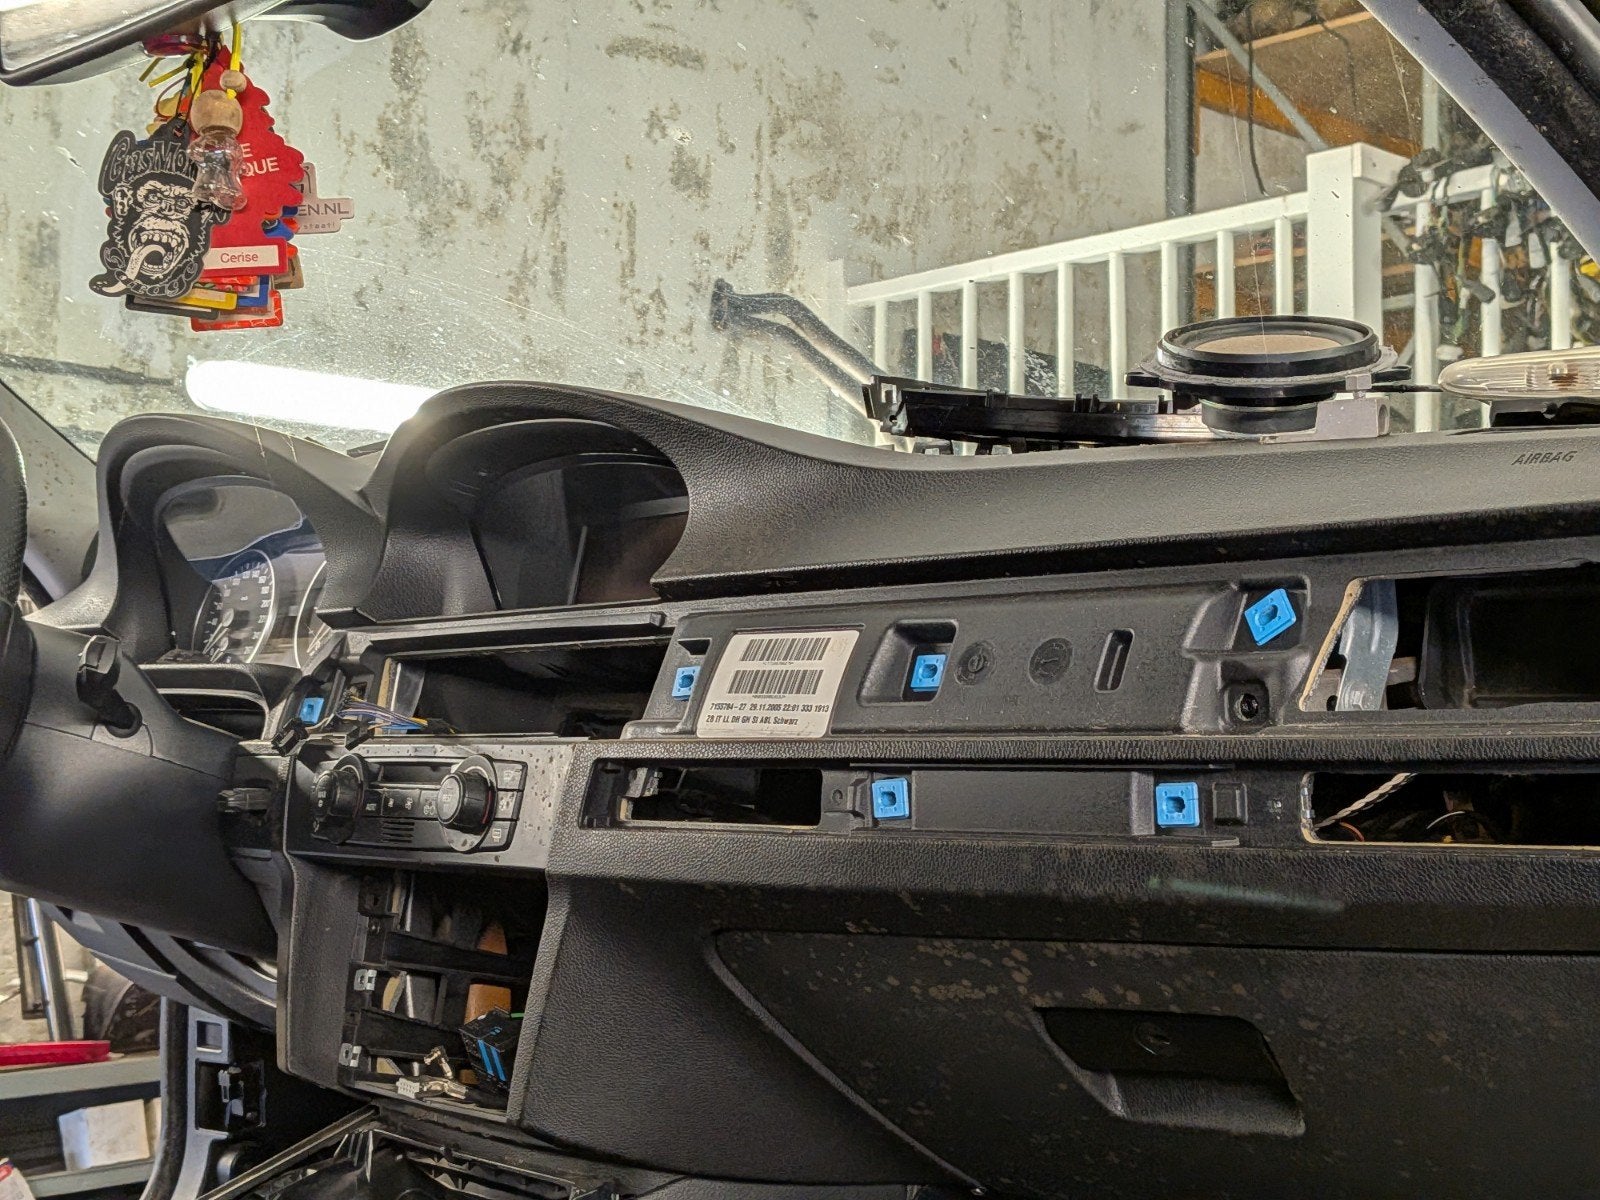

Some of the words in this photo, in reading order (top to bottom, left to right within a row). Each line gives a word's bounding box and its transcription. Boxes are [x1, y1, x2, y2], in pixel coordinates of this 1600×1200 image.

[241, 157, 279, 176] QUE
[298, 203, 350, 216] EN.NL
[220, 252, 259, 263] Cerise
[1511, 451, 1577, 465] AIRBAG
